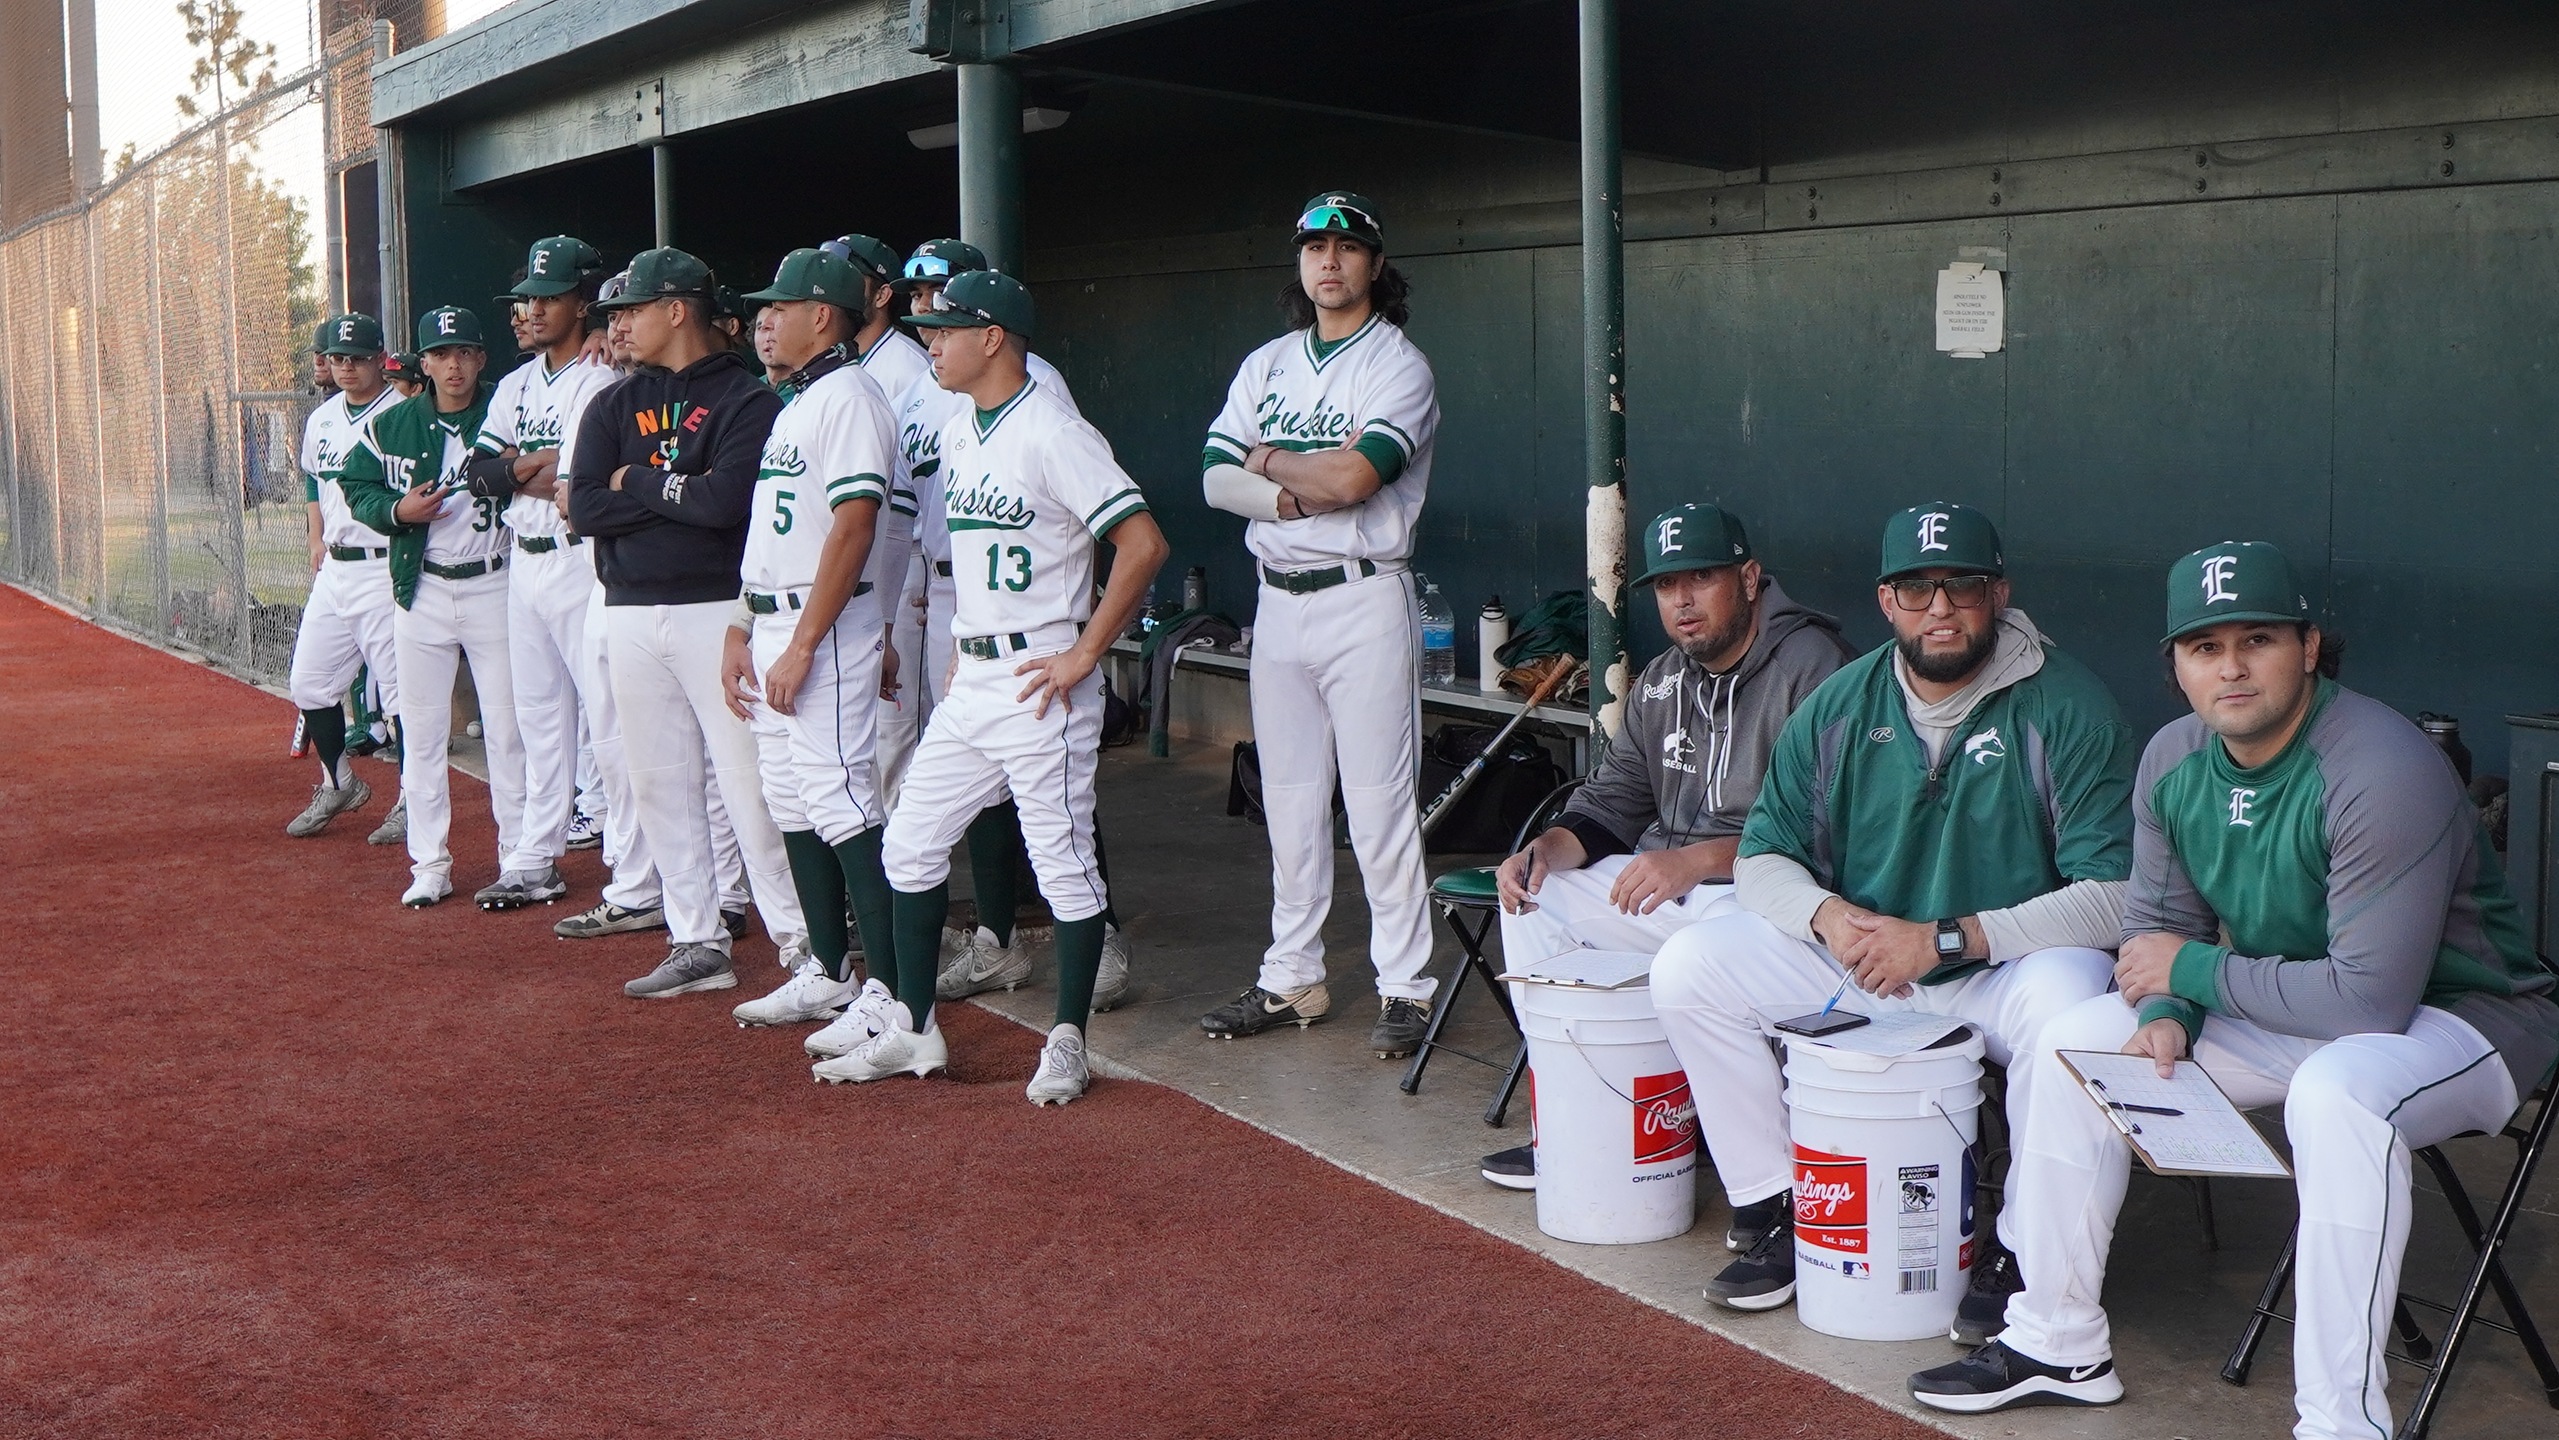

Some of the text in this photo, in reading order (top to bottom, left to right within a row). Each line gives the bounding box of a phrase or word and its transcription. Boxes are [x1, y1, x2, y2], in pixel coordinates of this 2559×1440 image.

[532, 250, 550, 275] E
[338, 321, 355, 342] E
[438, 312, 457, 335] E
[772, 490, 795, 535] 5
[1658, 517, 1683, 556] E
[1917, 512, 1950, 553] E
[986, 543, 1032, 592] 13
[2201, 556, 2239, 606] E
[2228, 788, 2256, 827] E
[1632, 1171, 1675, 1183] OFFICIAL
[1821, 1234, 1861, 1248] Est. 1887
